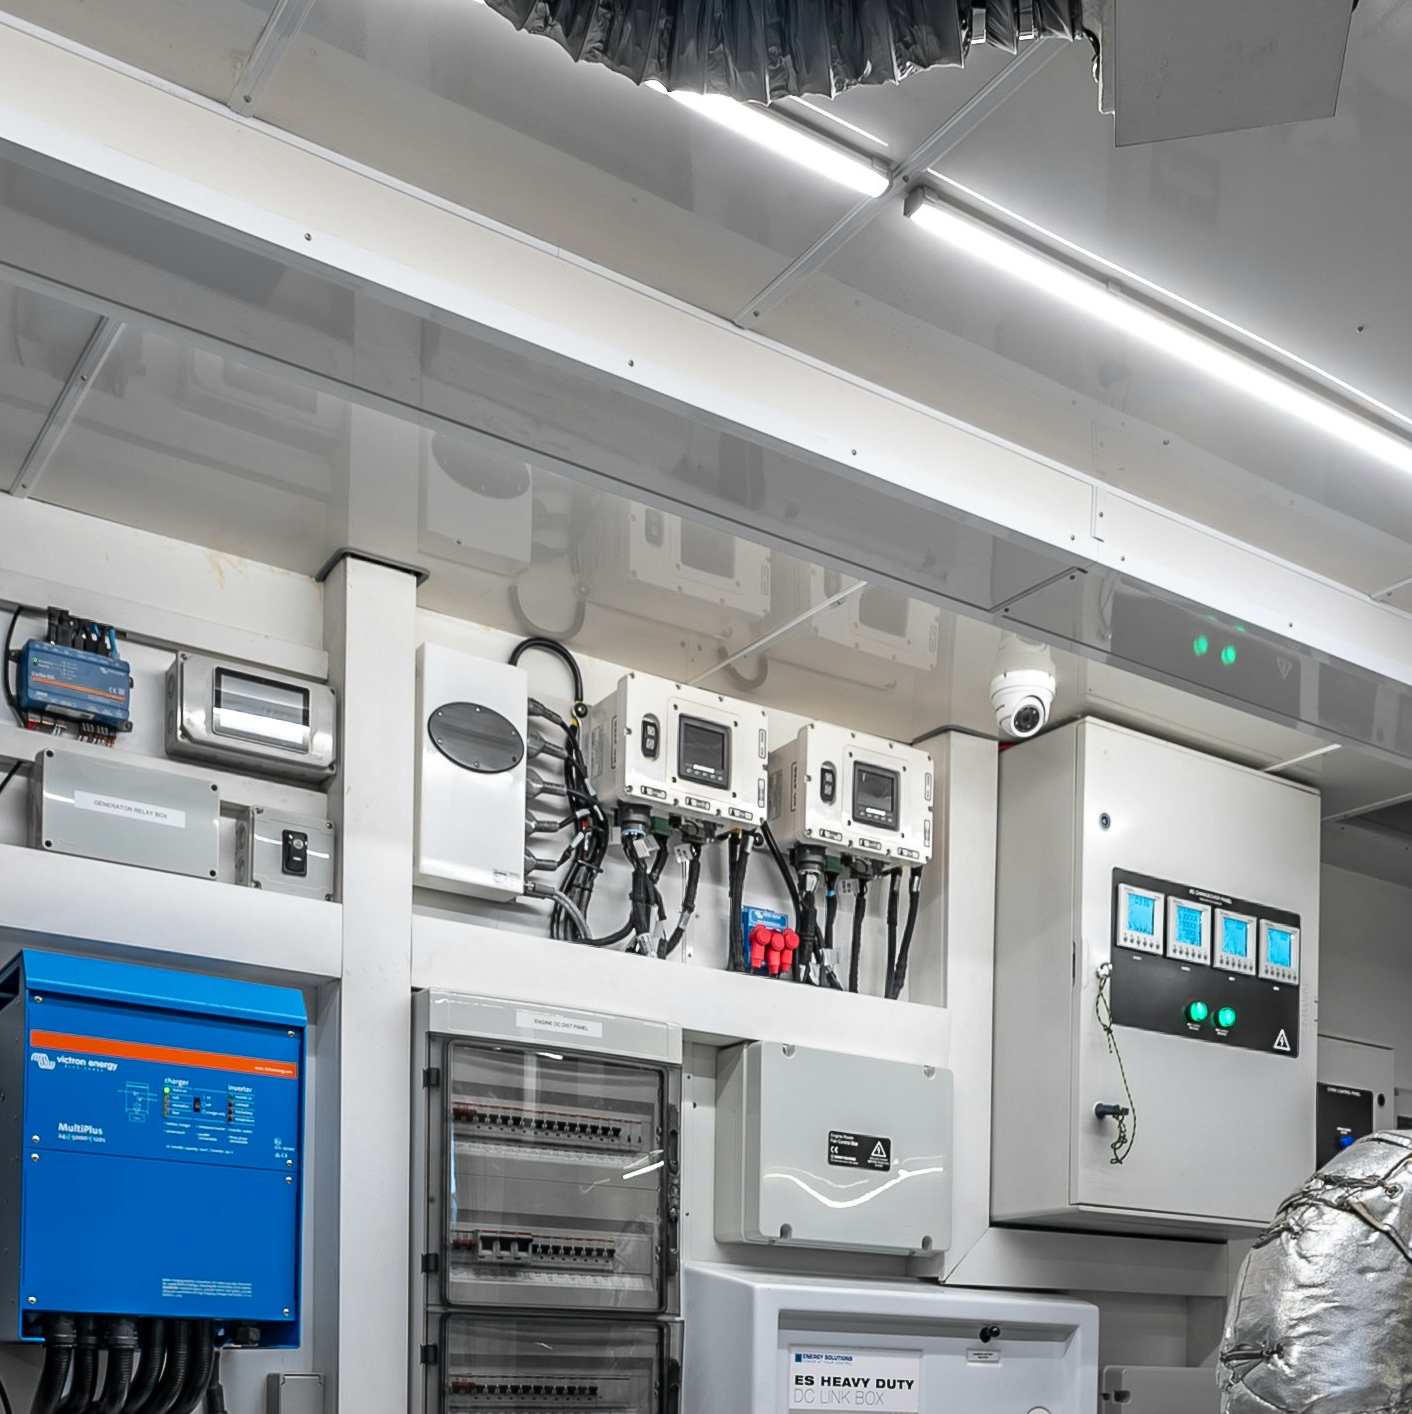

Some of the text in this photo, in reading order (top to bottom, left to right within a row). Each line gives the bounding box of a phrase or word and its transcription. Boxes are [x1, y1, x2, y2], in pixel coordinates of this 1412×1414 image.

[94, 799, 168, 820] GENERATOR RELAY BOX
[534, 1018, 552, 1027] ENGINE
[561, 1021, 573, 1029] DIST
[573, 1023, 589, 1032] PANEL
[57, 1055, 118, 1072] victron energy
[164, 1077, 189, 1088] charger
[227, 1084, 252, 1093] inverter
[58, 1122, 103, 1136] MultiPlus
[802, 1353, 853, 1362] ENERGY SOLUTIONS
[794, 1374, 915, 1390] ES HEAVY DUTY
[793, 1388, 885, 1406] DC LINK BOX
